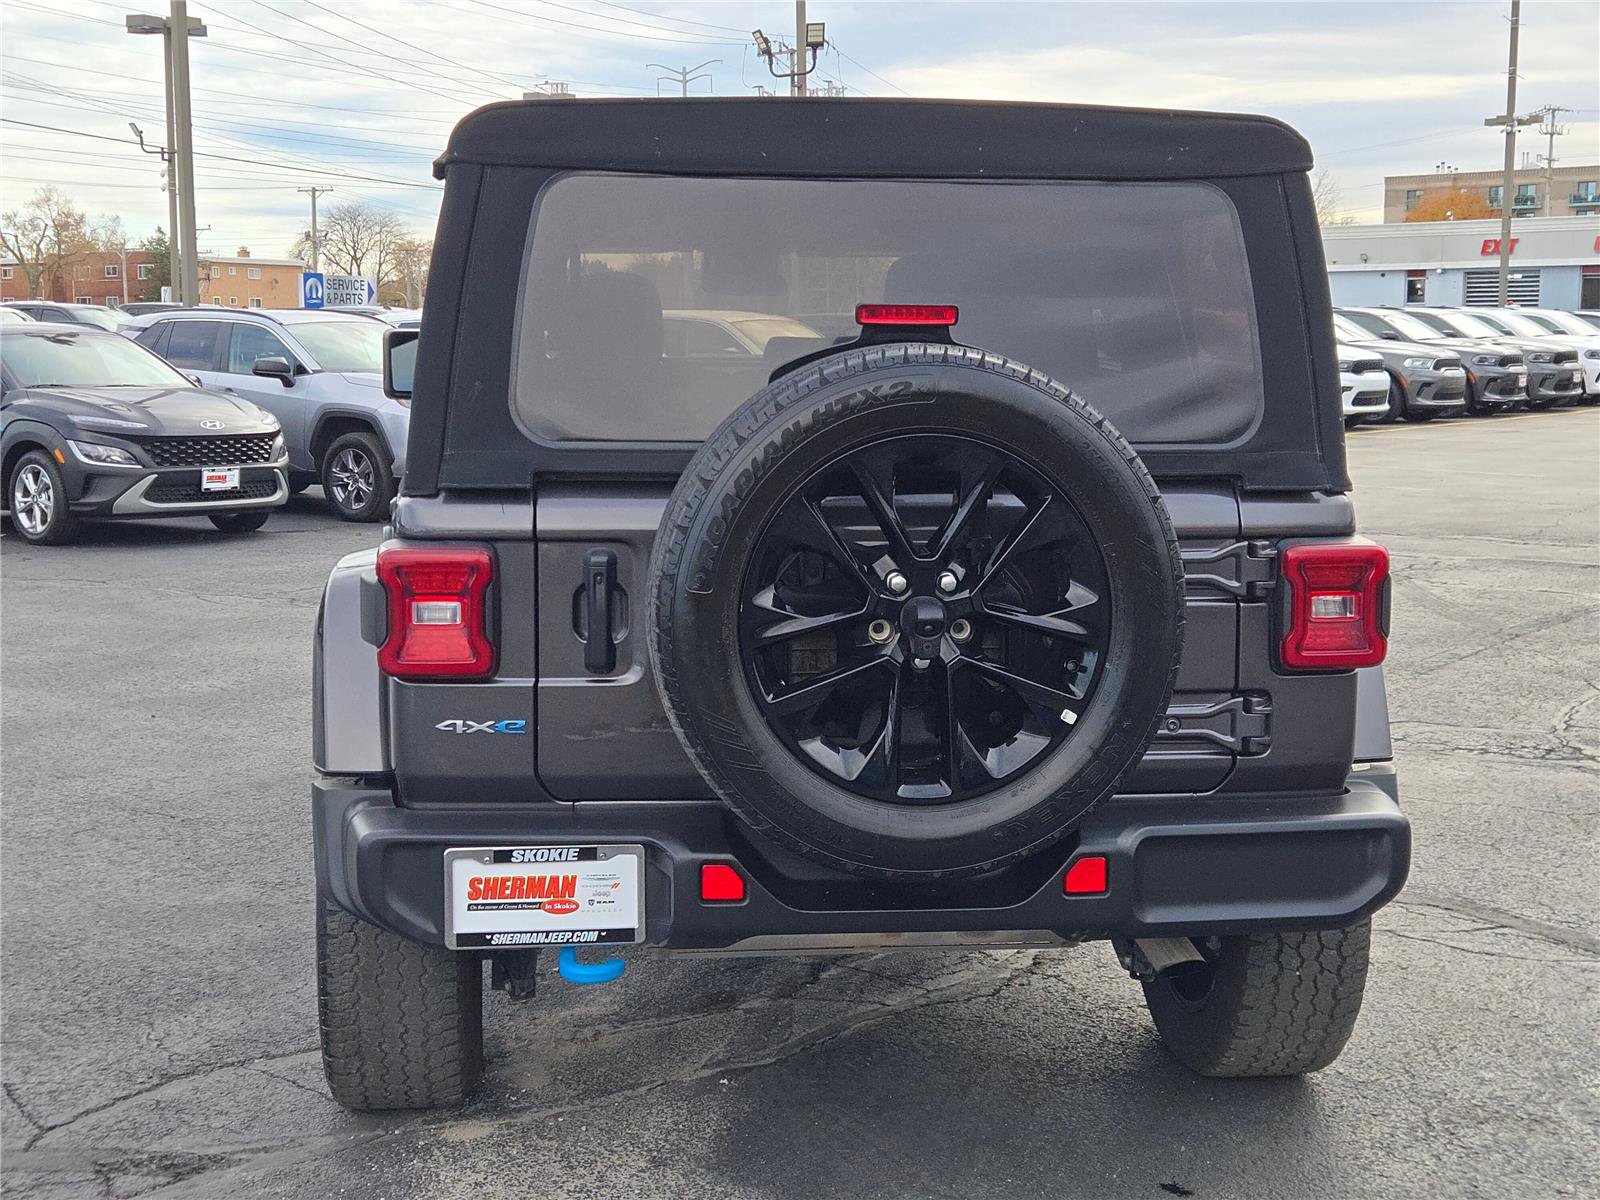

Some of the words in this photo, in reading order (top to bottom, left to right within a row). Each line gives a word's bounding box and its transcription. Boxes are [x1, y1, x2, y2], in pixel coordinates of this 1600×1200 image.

[1481, 238, 1519, 256] EXT
[326, 278, 366, 291] SERVICE
[326, 293, 332, 304] &
[333, 292, 364, 305] PARTS
[511, 848, 580, 863] SKOKIE
[467, 874, 578, 901] SHERMAN
[491, 931, 599, 945] SHERMANJEEP.COM
